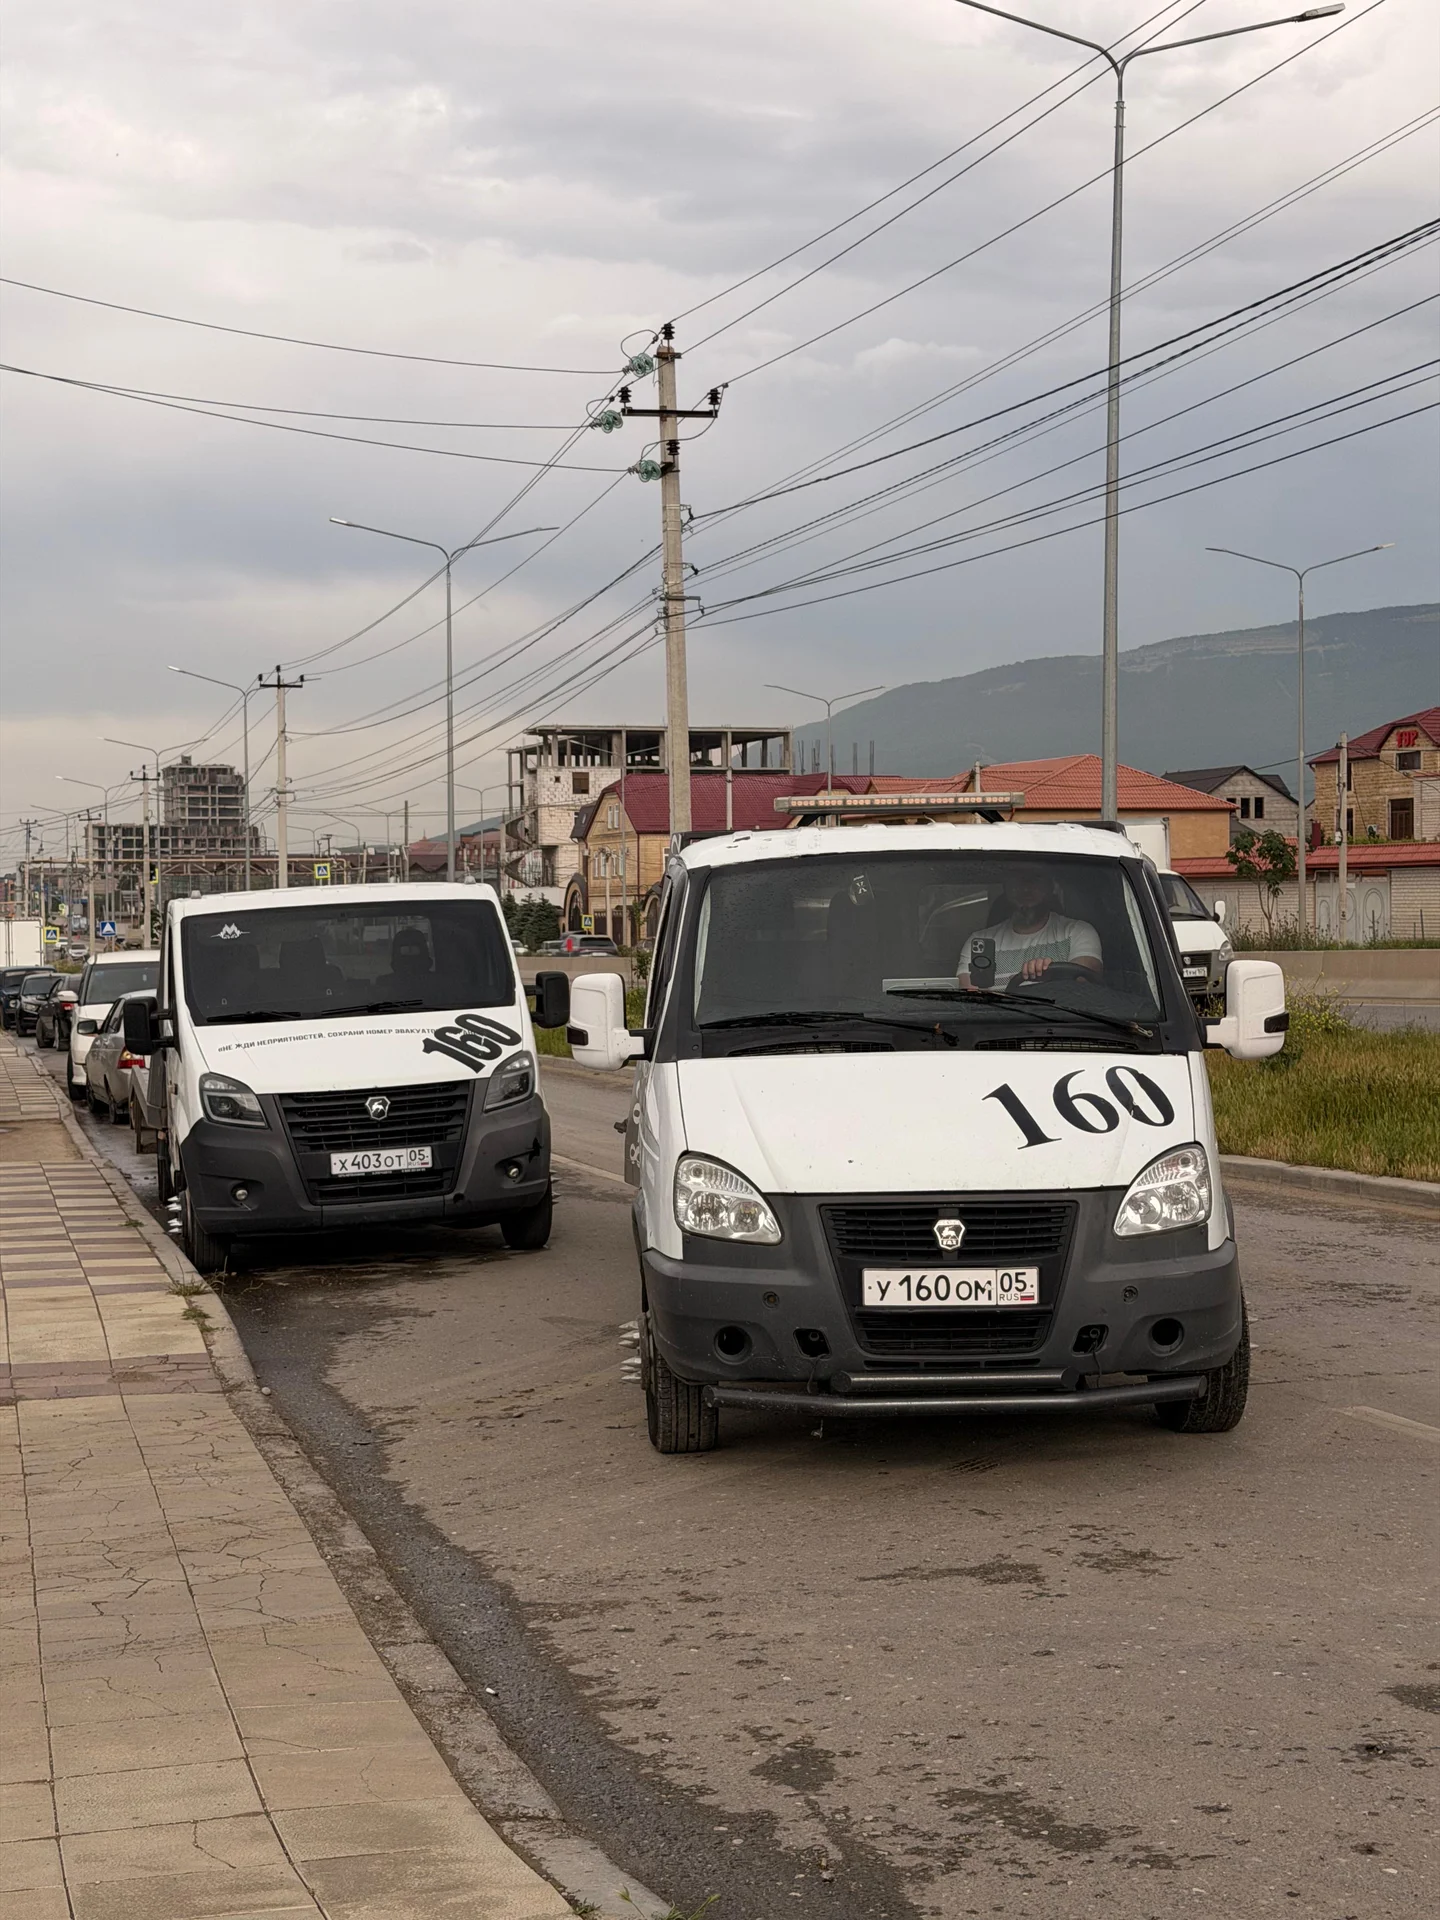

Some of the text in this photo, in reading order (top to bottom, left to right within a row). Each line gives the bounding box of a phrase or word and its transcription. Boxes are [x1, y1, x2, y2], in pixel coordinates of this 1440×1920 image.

[235, 1041, 256, 1050] ЖДИ
[327, 1030, 364, 1039] СОХРАНИ
[422, 1013, 522, 1074] 160
[981, 1065, 1175, 1150] 160
[409, 1149, 426, 1161] 05
[876, 1274, 992, 1301] У160ОМ
[1000, 1272, 1027, 1292] 05
[1000, 1293, 1019, 1301] RUS
